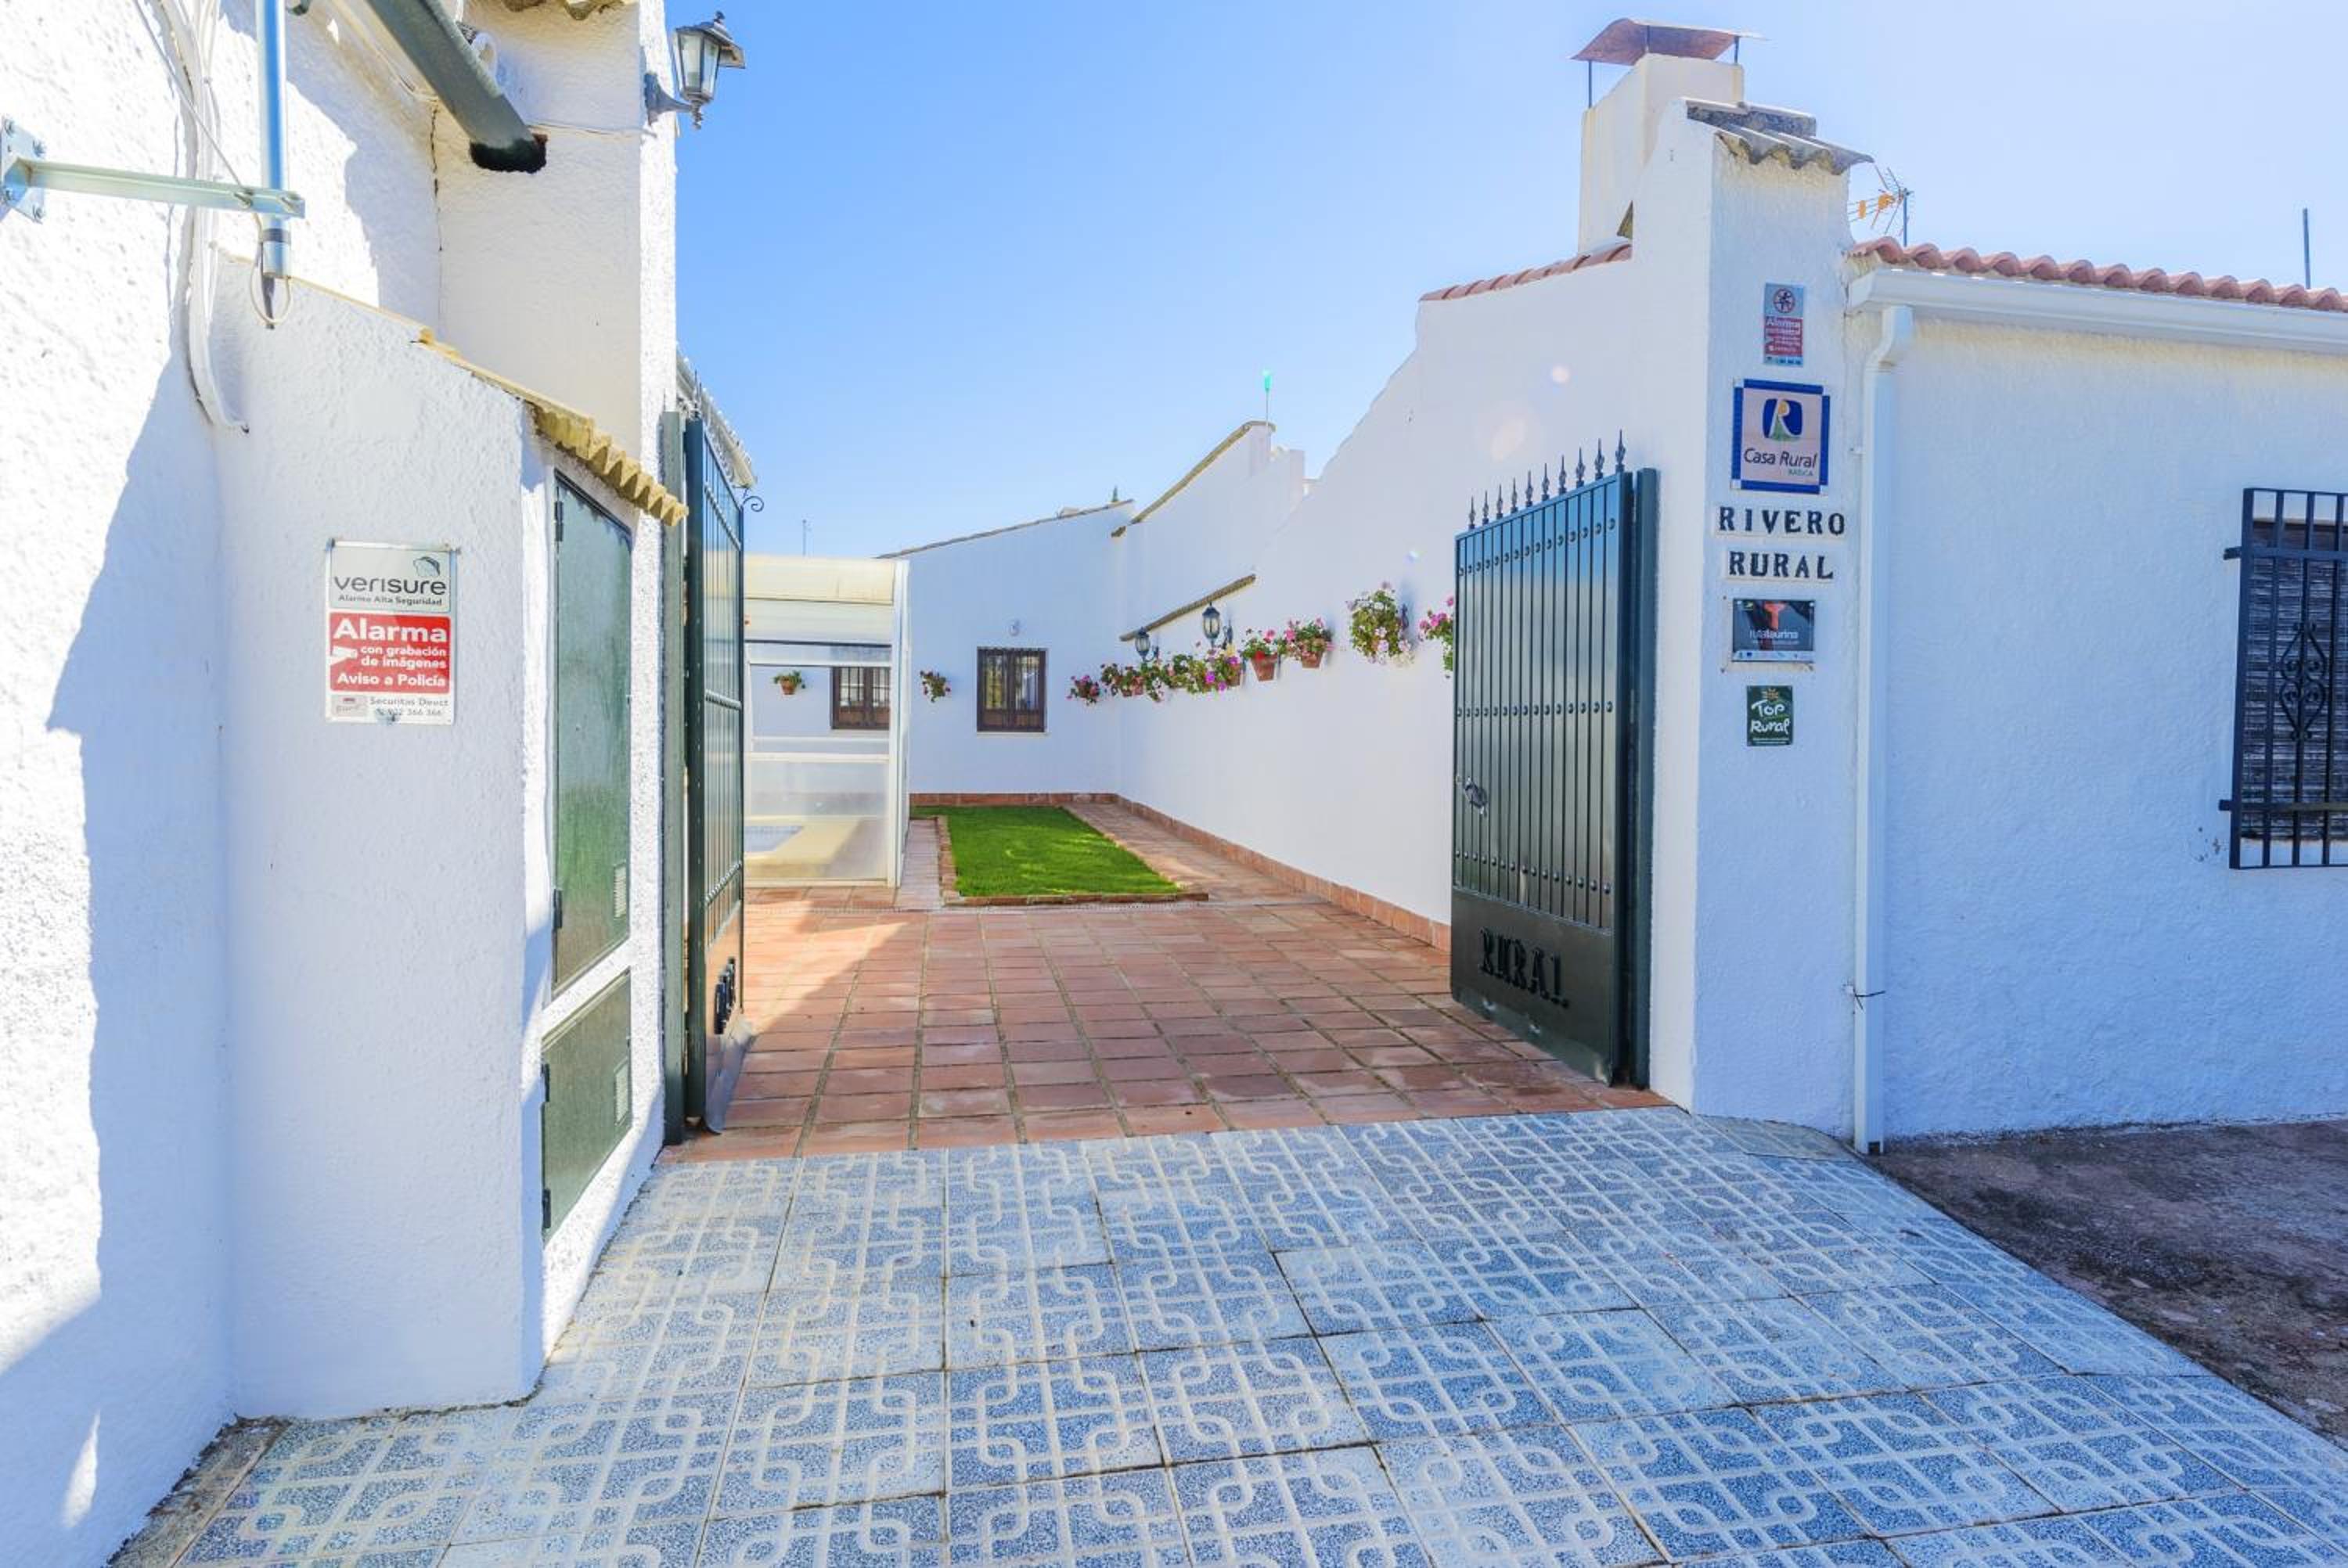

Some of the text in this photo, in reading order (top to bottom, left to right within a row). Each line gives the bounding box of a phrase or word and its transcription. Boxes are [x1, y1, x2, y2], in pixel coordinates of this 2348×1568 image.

[1743, 448, 1818, 469] Casa Rural
[1719, 506, 1846, 536] RIVERO
[1729, 551, 1835, 580] RURAL
[334, 577, 447, 595] verisure
[338, 594, 372, 602] Alarma
[395, 596, 443, 606] Seguridad
[333, 617, 447, 642] Alarma
[360, 644, 447, 658] con grabación
[361, 655, 447, 671] de imágenes
[337, 672, 446, 687] Aviso a Policía
[1750, 718, 1791, 735] Rural
